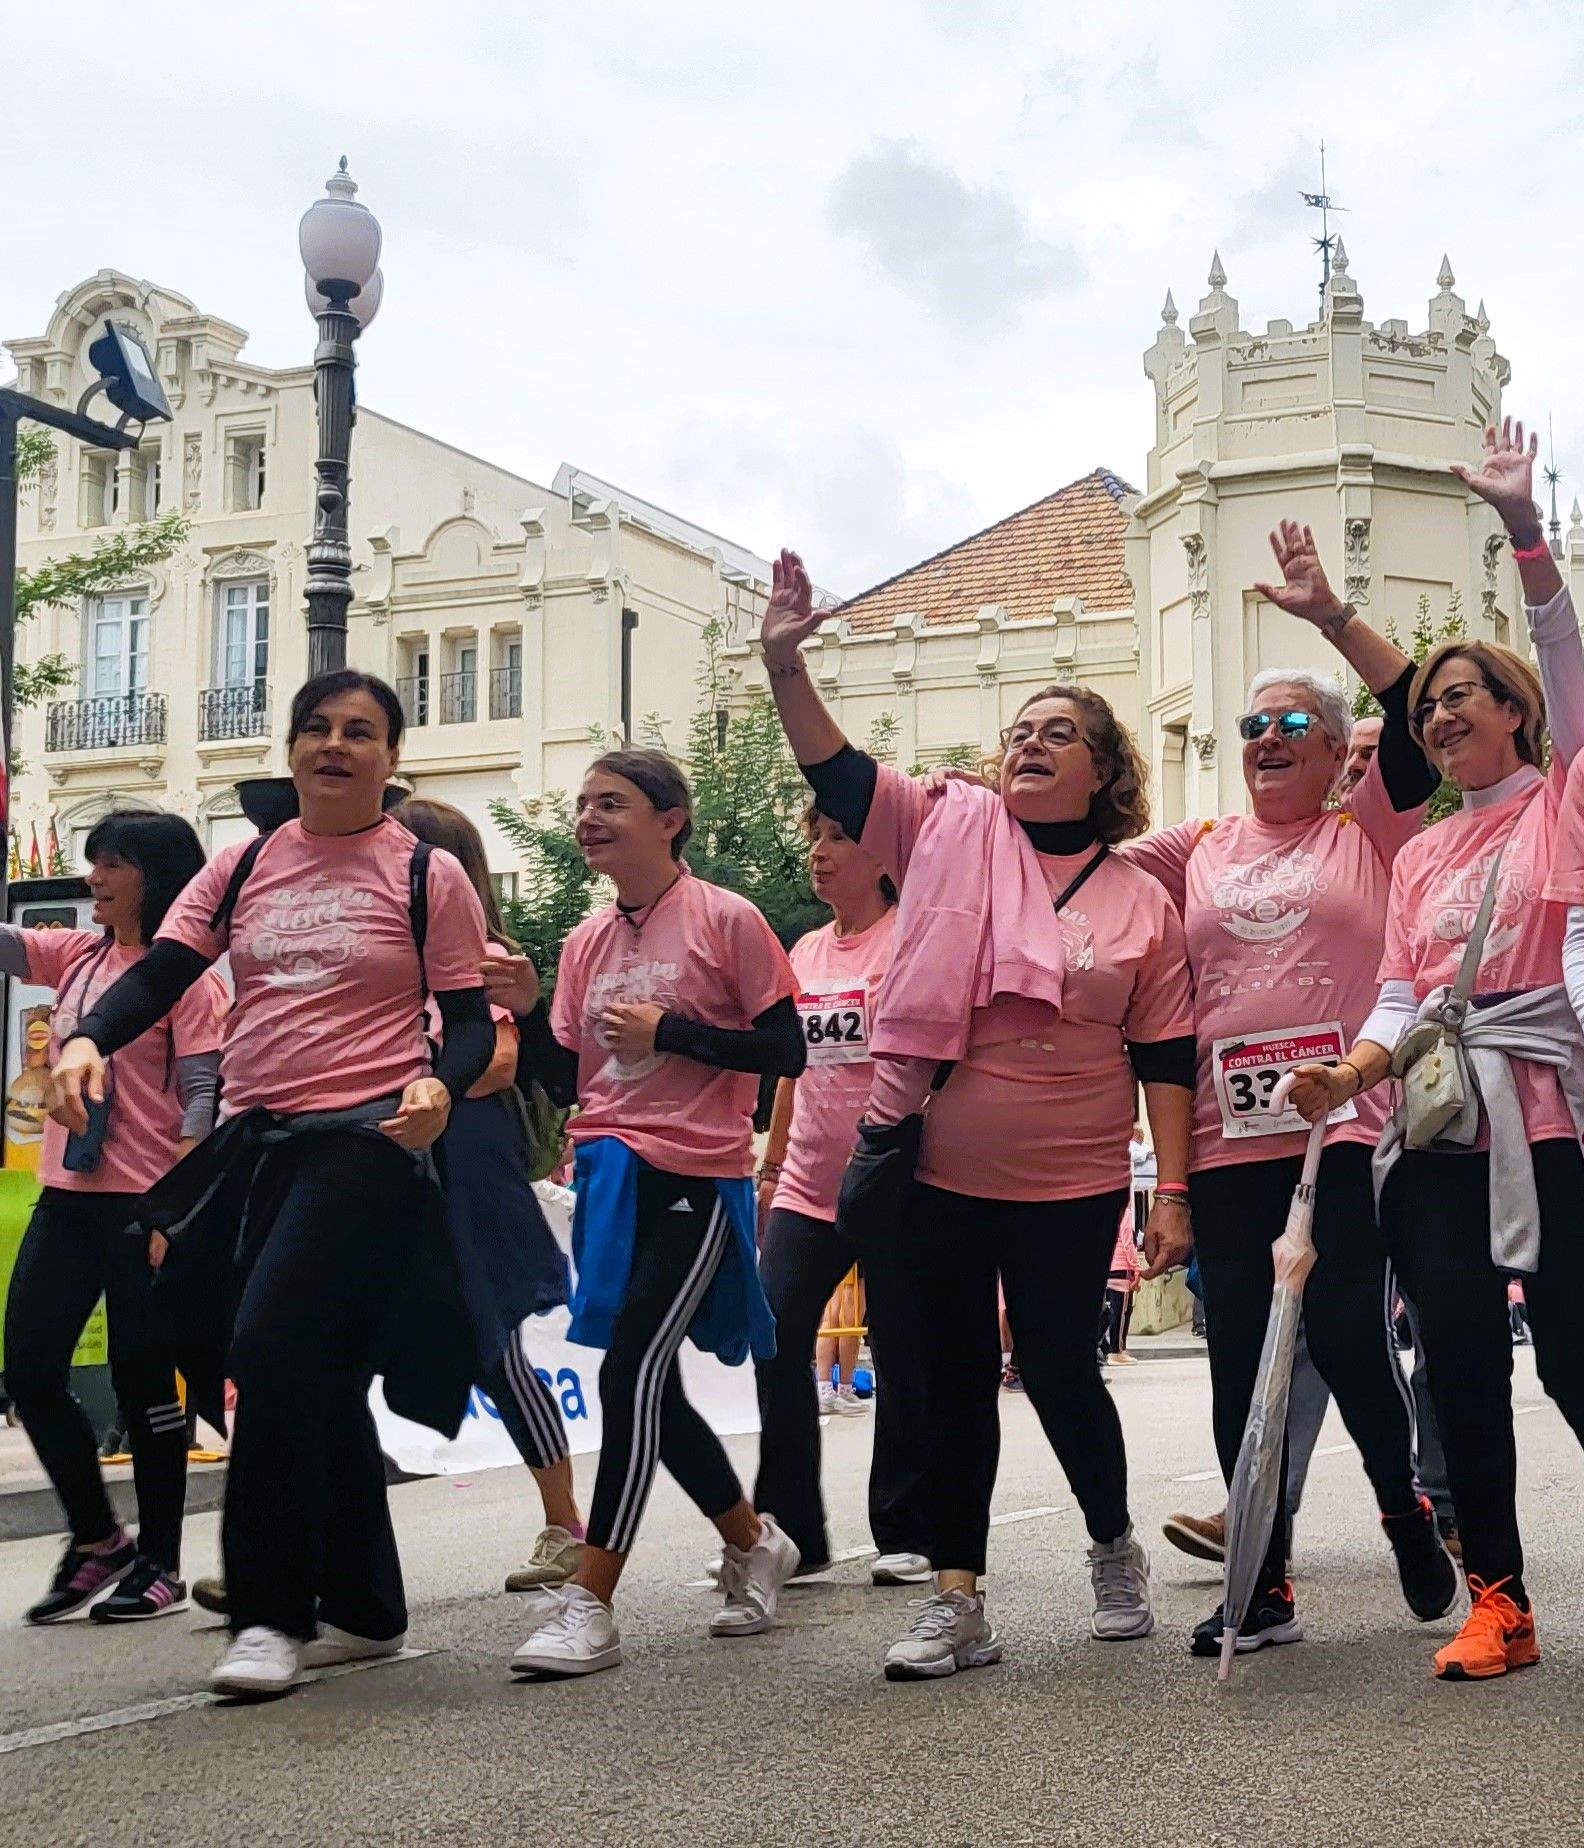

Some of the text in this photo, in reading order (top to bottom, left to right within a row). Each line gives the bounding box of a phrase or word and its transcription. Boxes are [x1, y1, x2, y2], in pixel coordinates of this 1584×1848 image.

[805, 1011, 863, 1044] 842
[1228, 1043, 1336, 1069] CONTRA EL CÁNCER
[1262, 1040, 1296, 1052] HUESCA
